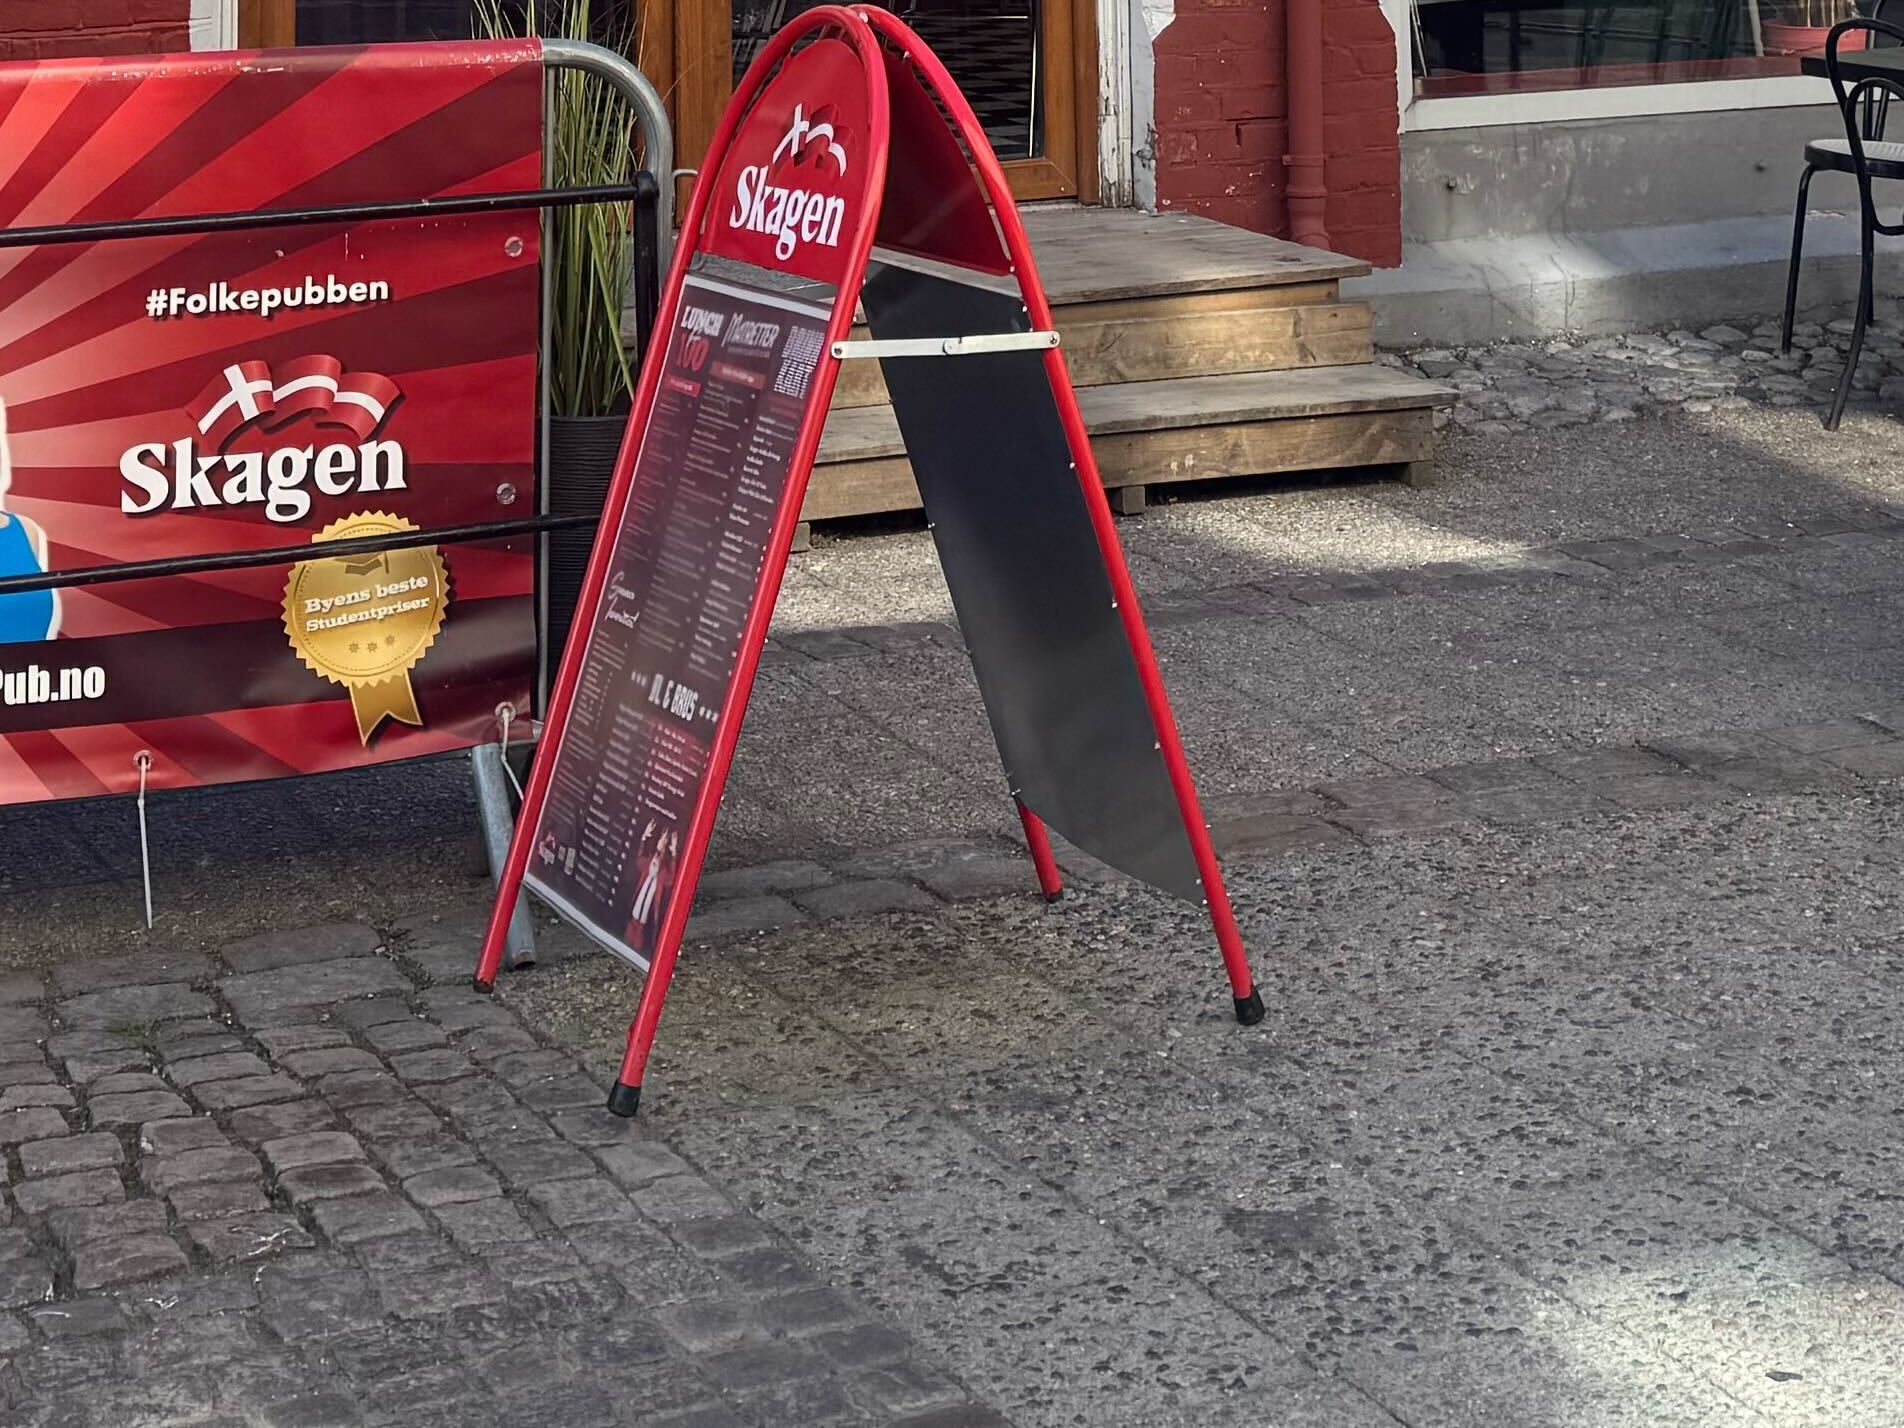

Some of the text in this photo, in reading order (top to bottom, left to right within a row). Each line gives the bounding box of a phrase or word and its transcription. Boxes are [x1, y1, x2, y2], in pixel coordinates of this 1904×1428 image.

[729, 165, 845, 261] Skagen
[146, 274, 389, 317] #Folkepubben
[119, 436, 407, 522] Skagen
[304, 575, 430, 614] Byens beste
[306, 596, 430, 632] Studentpriser
